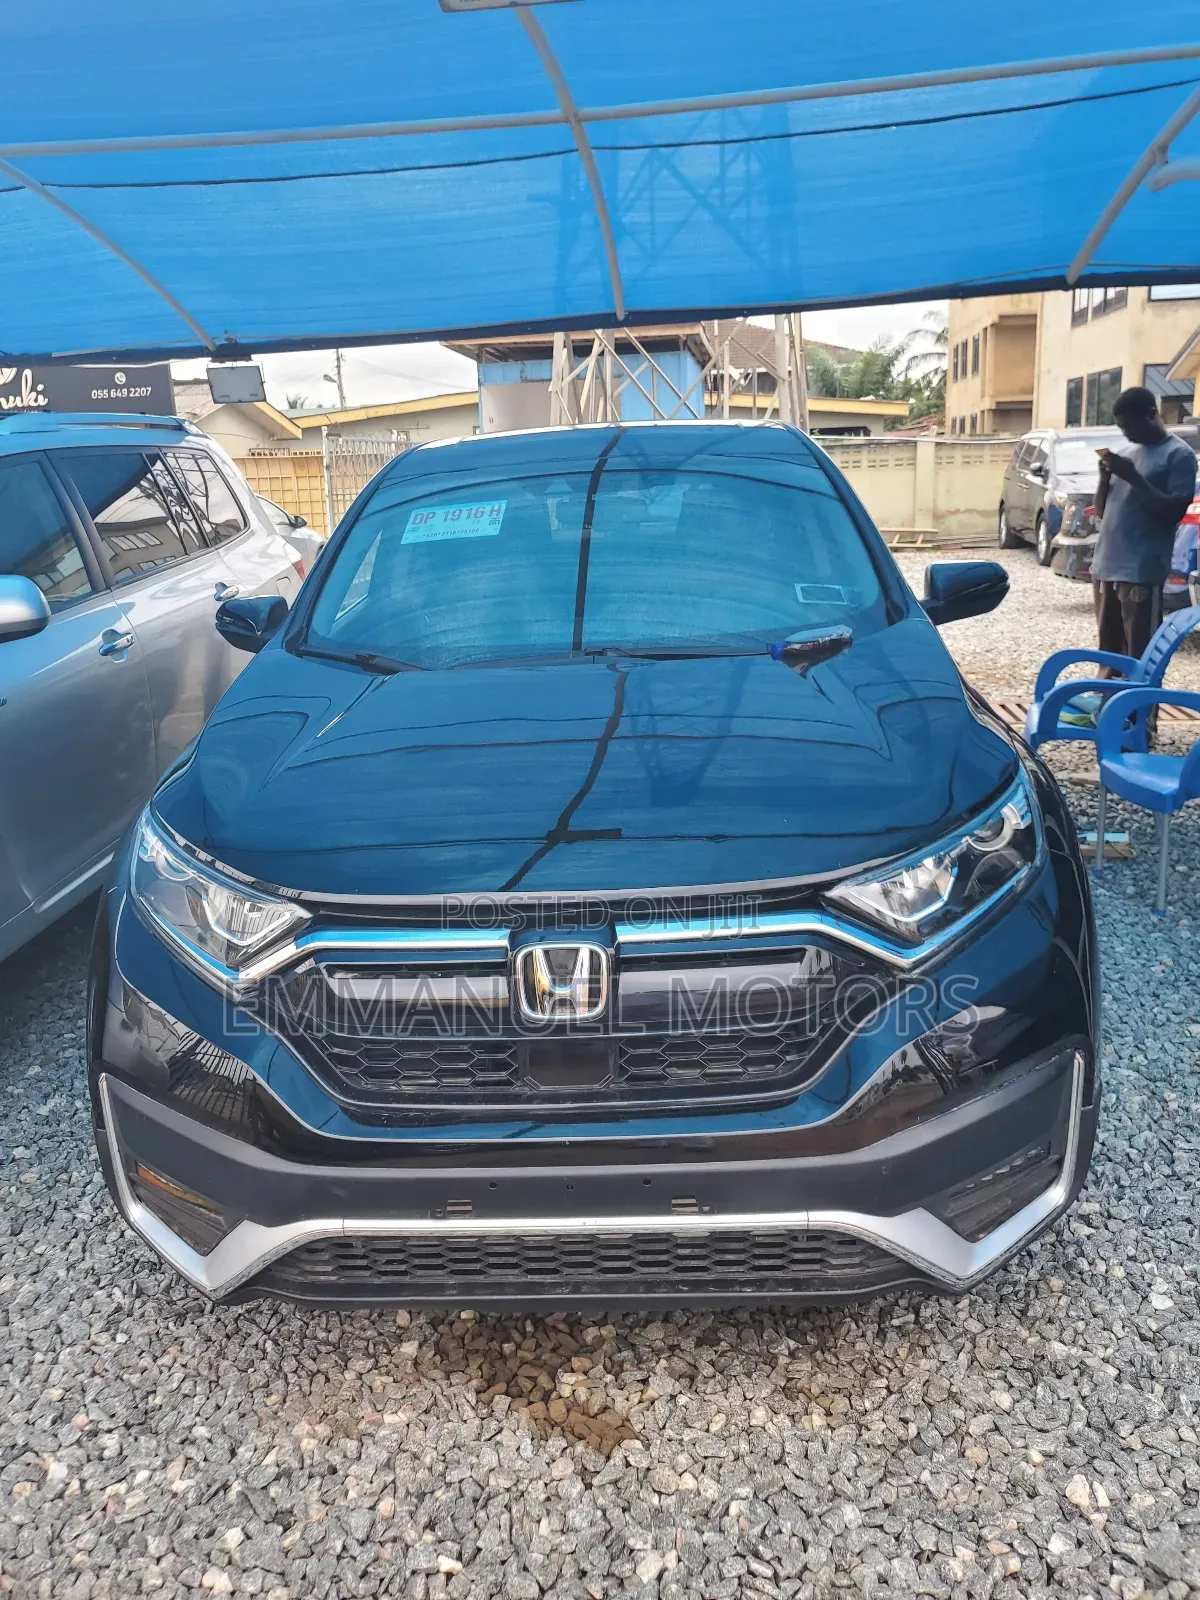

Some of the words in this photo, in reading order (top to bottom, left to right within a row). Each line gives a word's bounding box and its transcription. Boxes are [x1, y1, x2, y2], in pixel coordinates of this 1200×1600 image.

[92, 389, 109, 399] 055
[110, 388, 128, 398] 649
[129, 386, 152, 397] 2207
[412, 512, 436, 525] DP
[443, 507, 486, 522] 1916
[489, 505, 503, 517] H
